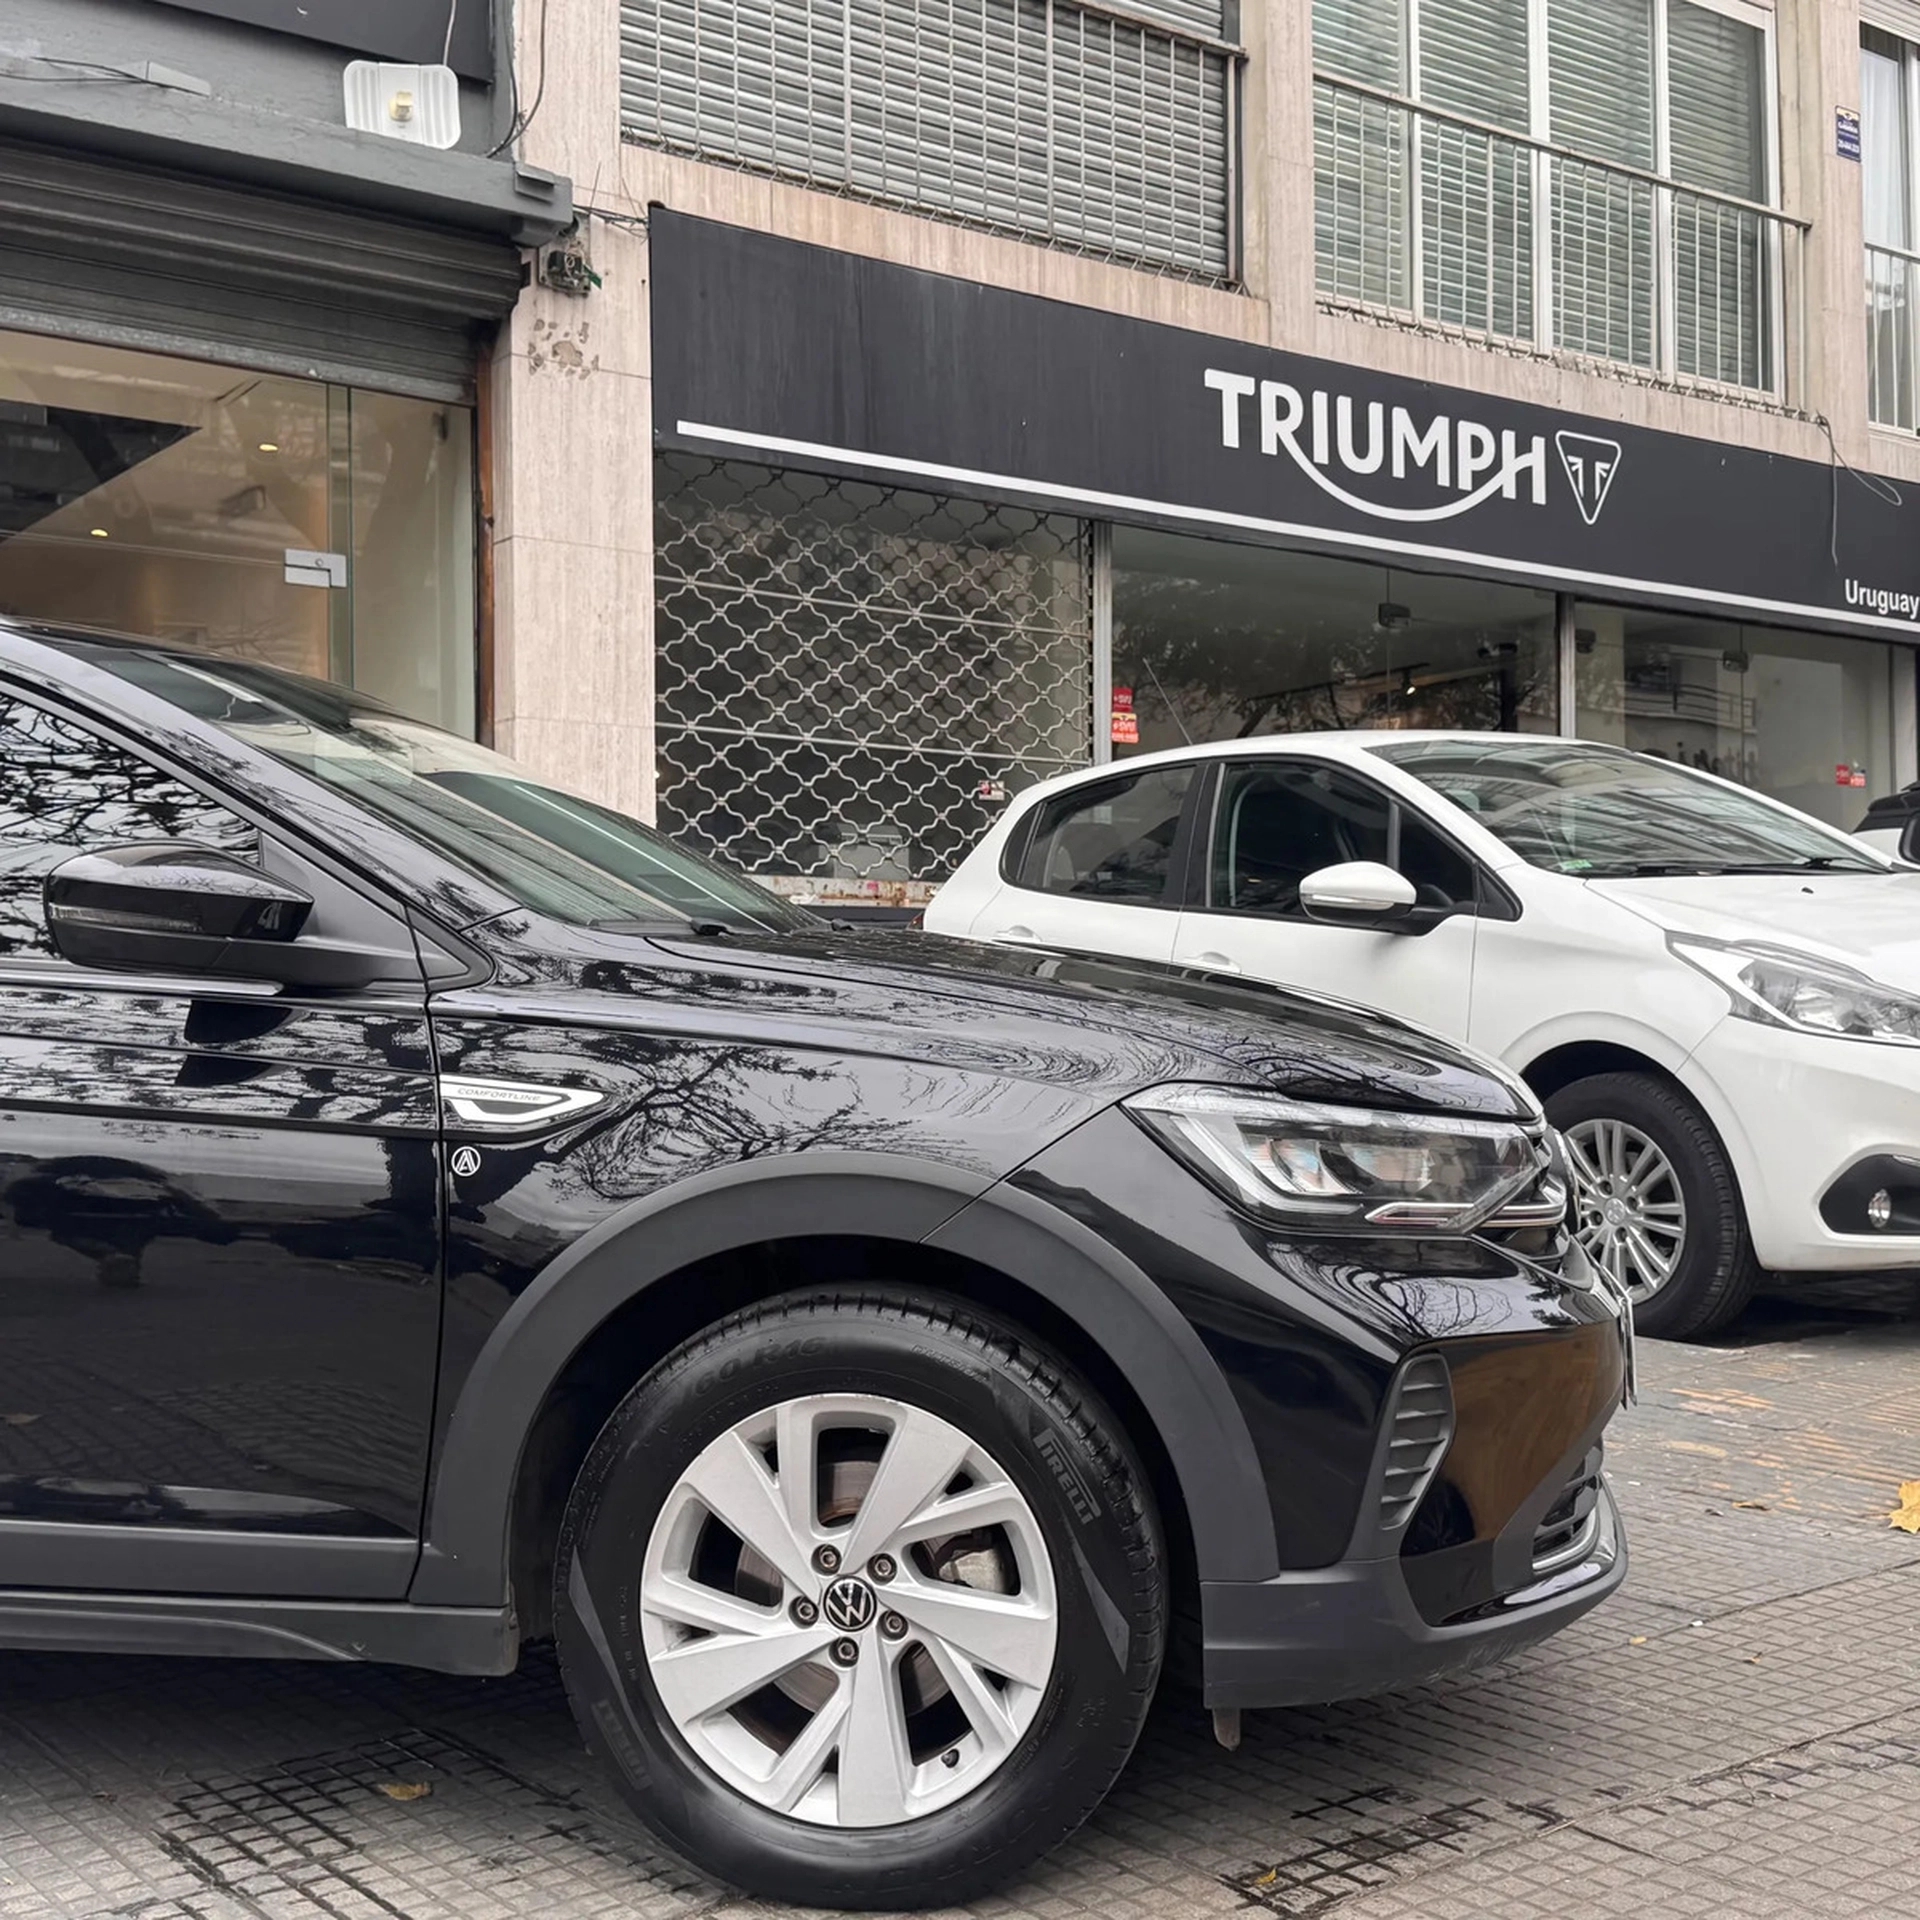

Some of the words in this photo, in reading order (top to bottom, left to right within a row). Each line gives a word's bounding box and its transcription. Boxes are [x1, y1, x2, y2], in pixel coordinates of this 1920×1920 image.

[1204, 369, 1547, 522] TRIUMPH
[1845, 578, 1920, 620] Uruguay
[457, 1087, 542, 1101] COMFORTLINE
[1033, 1428, 1102, 1524] PIRELLI
